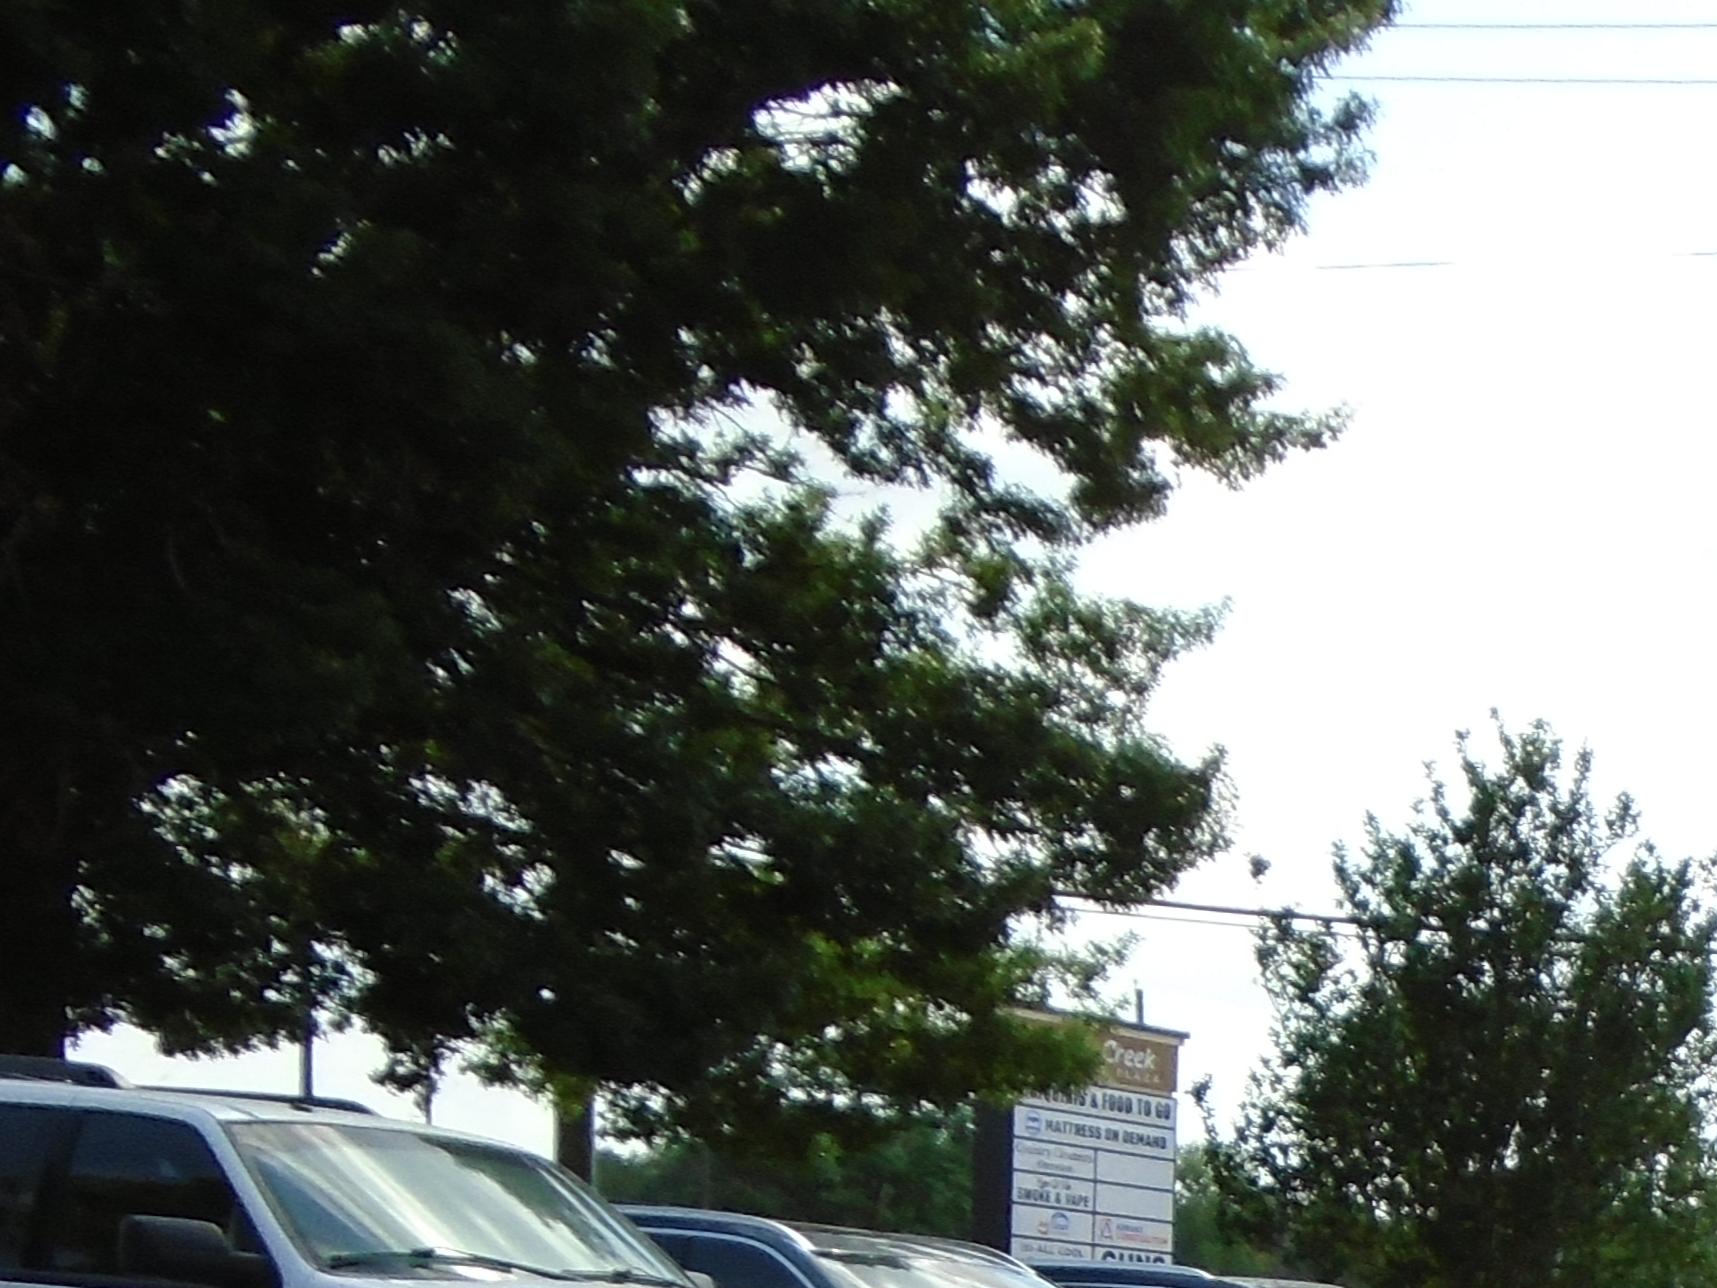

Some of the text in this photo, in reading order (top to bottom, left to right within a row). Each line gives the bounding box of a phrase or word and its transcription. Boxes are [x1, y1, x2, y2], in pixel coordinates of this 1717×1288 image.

[1102, 1039, 1156, 1070] Creek
[1101, 1092, 1134, 1115] FOOD
[1137, 1097, 1153, 1118] TO
[1155, 1102, 1171, 1121] GO
[1045, 1119, 1168, 1151] MATTRESS ON DEMAND
